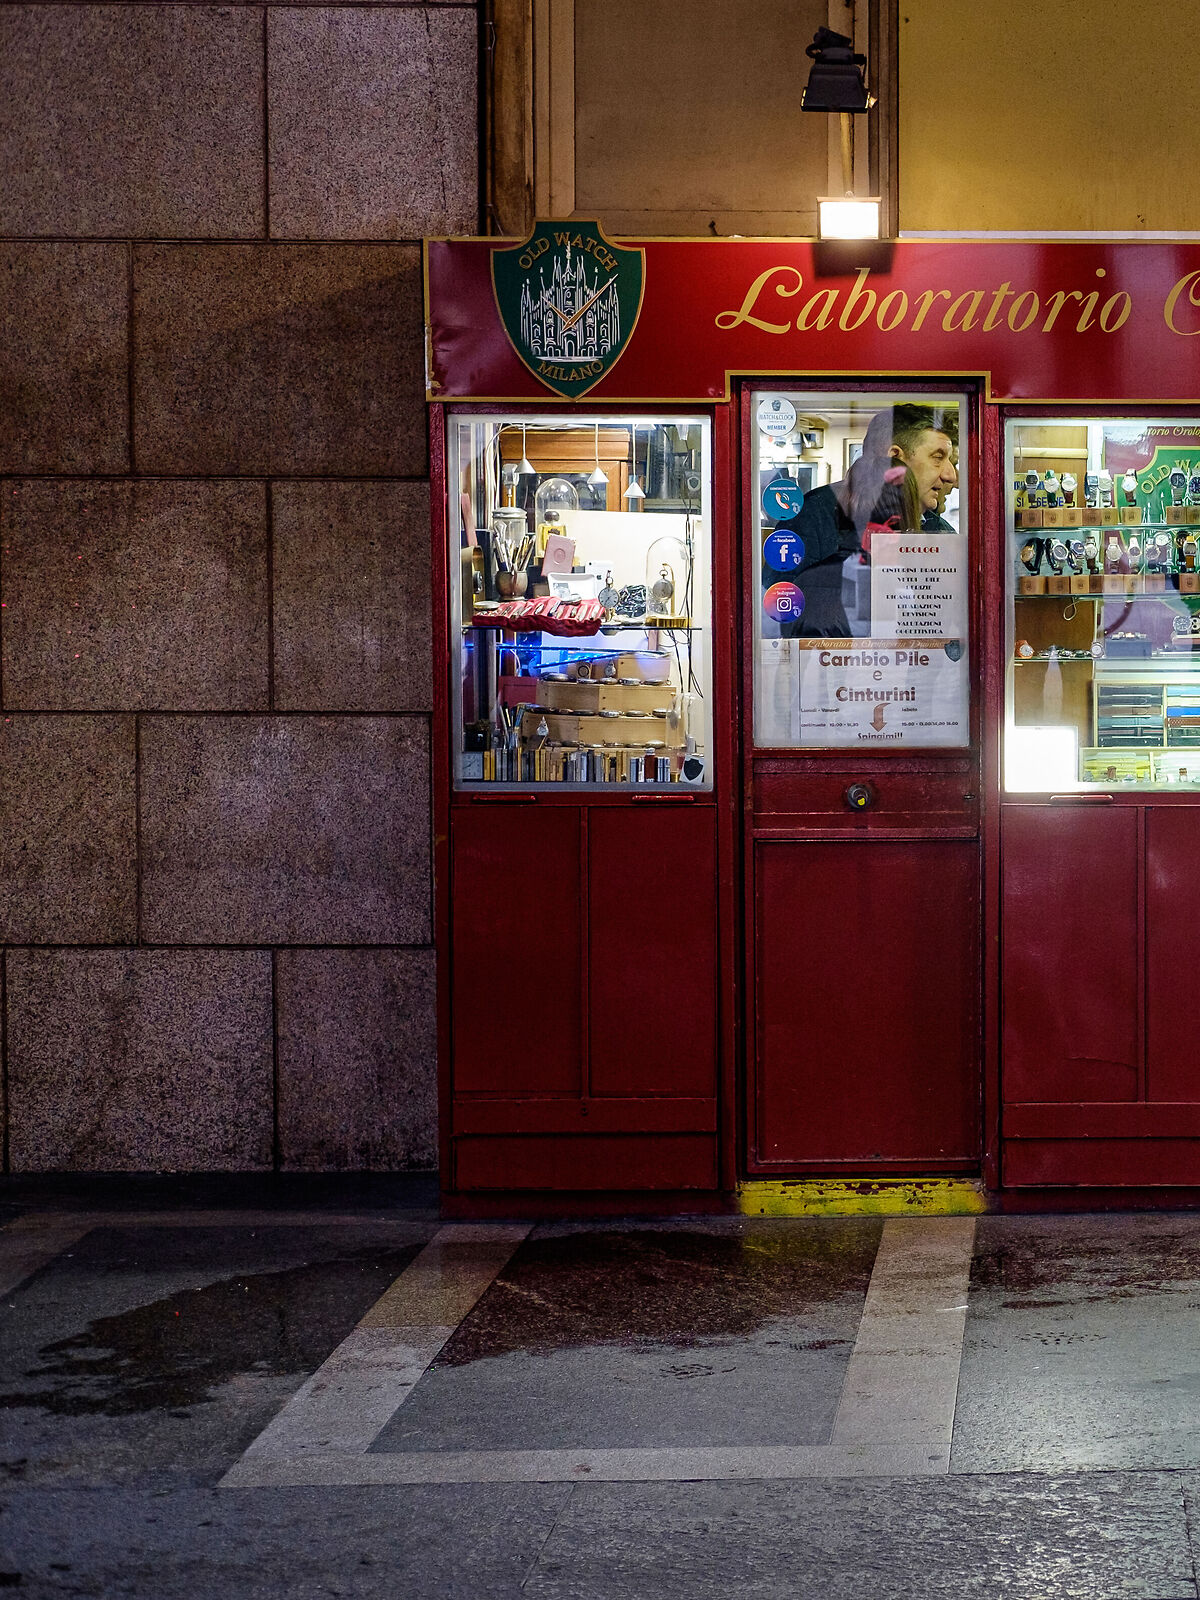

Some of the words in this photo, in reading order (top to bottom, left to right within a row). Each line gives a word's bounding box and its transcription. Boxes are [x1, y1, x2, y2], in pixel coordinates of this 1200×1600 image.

[518, 237, 550, 270] OLD
[553, 231, 619, 273] WATCH
[715, 266, 1132, 335] Laboratorio
[536, 360, 604, 381] MILANO
[1141, 463, 1171, 494] OLD
[898, 546, 940, 554] OROLOGI
[818, 651, 890, 667] Cambio
[895, 651, 930, 667] Pile
[873, 670, 883, 681] e
[835, 686, 916, 702] Cinturini
